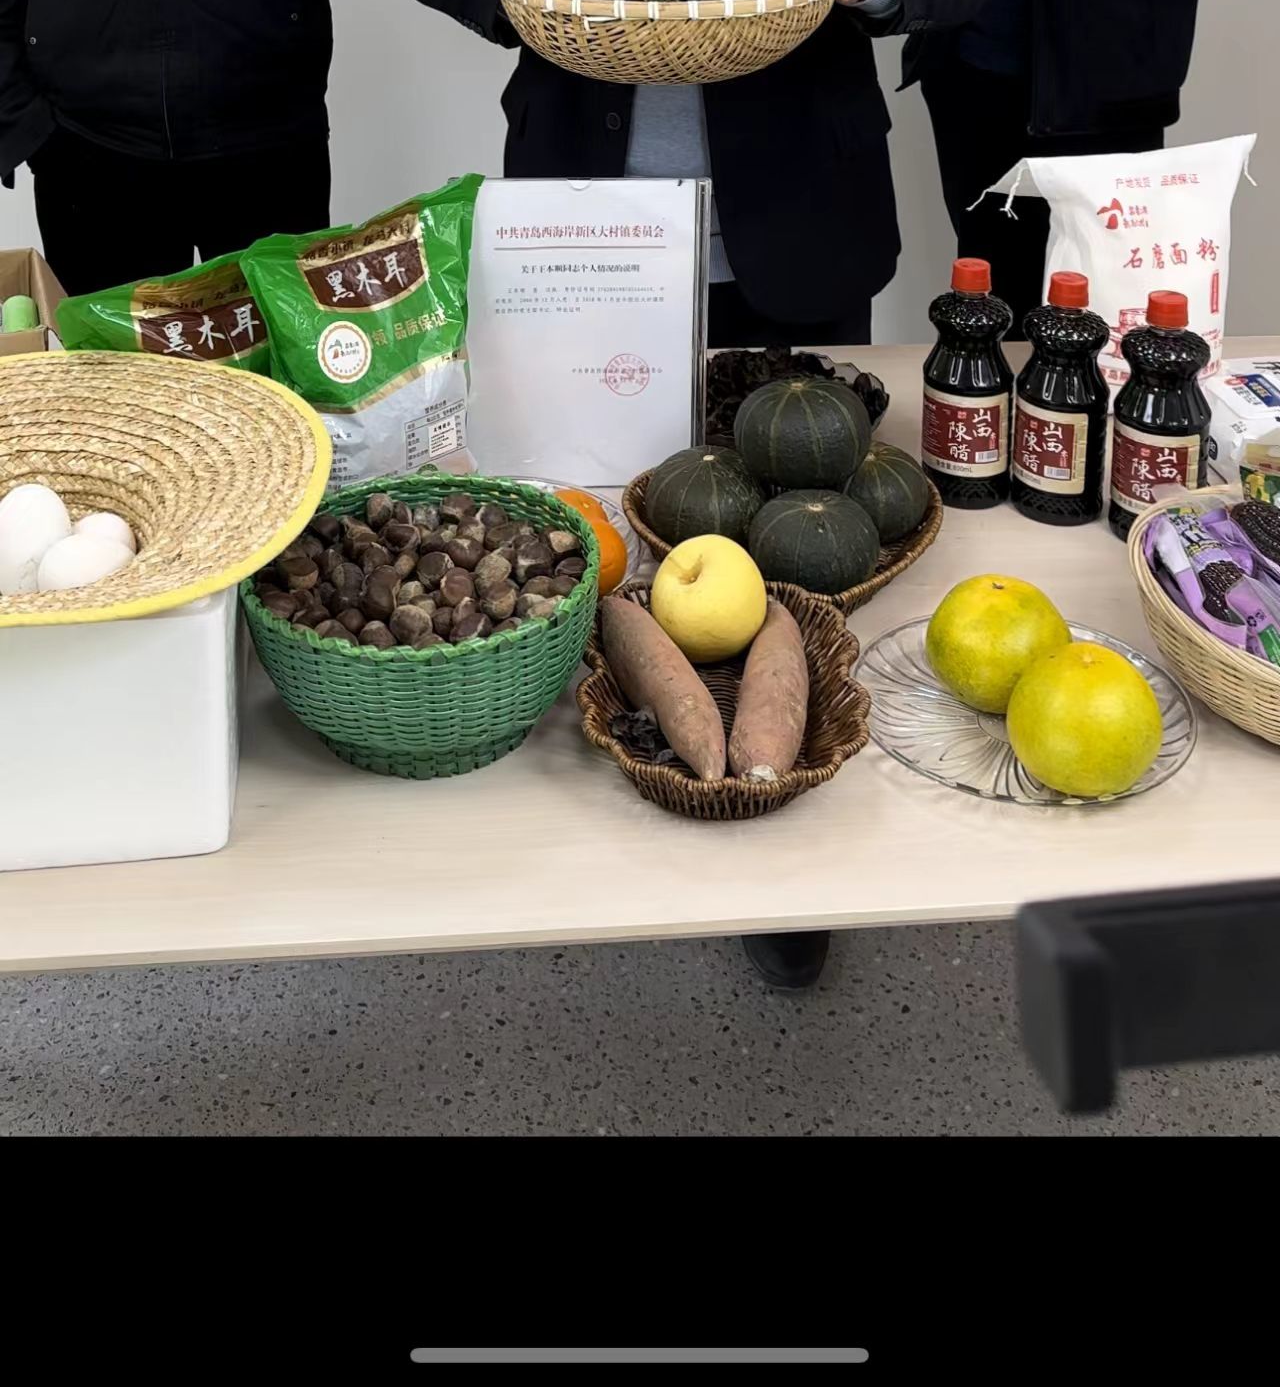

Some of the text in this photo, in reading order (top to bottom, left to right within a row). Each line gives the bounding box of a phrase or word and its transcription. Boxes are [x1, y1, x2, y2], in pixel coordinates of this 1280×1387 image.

[496, 224, 665, 239] 中共青岛西海岸新区大村镇委员会
[1123, 237, 1220, 270] 石磨面粉
[325, 251, 406, 303] 黑木耳
[162, 303, 260, 354] 黑木耳
[972, 409, 992, 438] 山西
[1042, 423, 1064, 454] 山西
[1156, 448, 1178, 479] 山西
